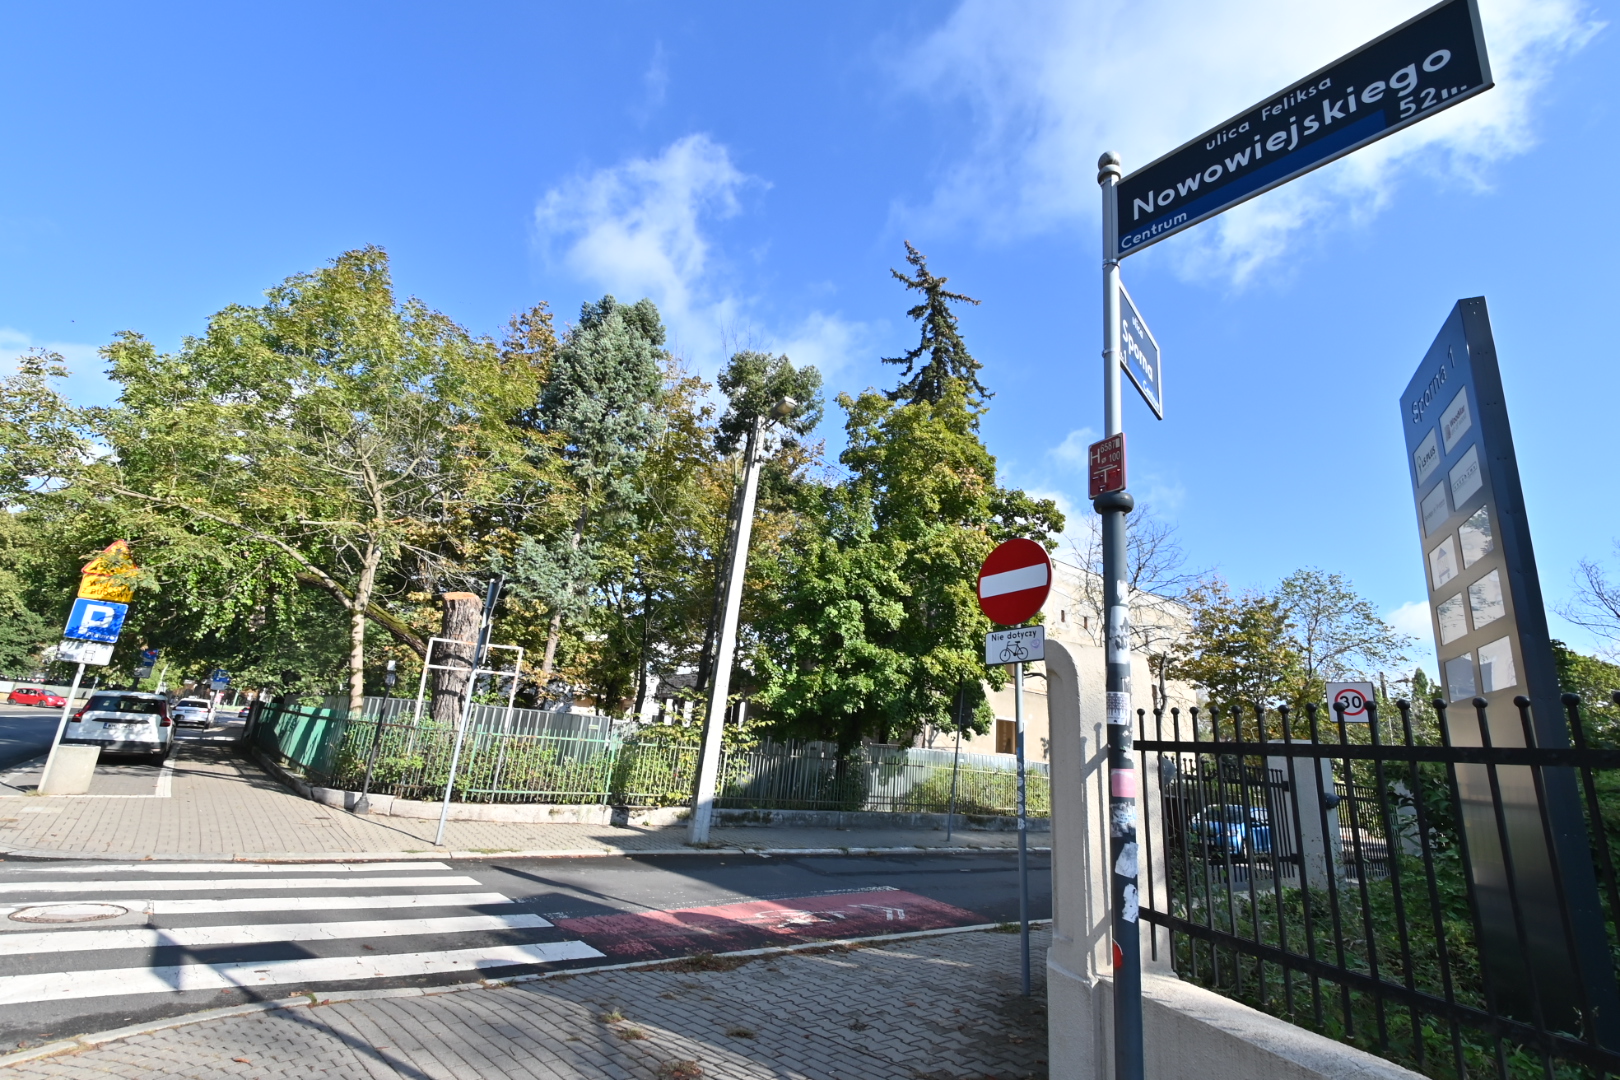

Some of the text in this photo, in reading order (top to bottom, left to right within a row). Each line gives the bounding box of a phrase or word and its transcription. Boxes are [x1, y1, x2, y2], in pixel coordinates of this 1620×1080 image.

[1132, 48, 1452, 221] Nowowiejskiego
[1205, 77, 1332, 152] ulica Feliksa
[1121, 211, 1188, 250] Centrum
[1122, 318, 1153, 383] Sporna
[1411, 344, 1455, 424] Sporna 1
[991, 630, 1037, 641] Nie dotyczy
[1339, 695, 1363, 709] 30
